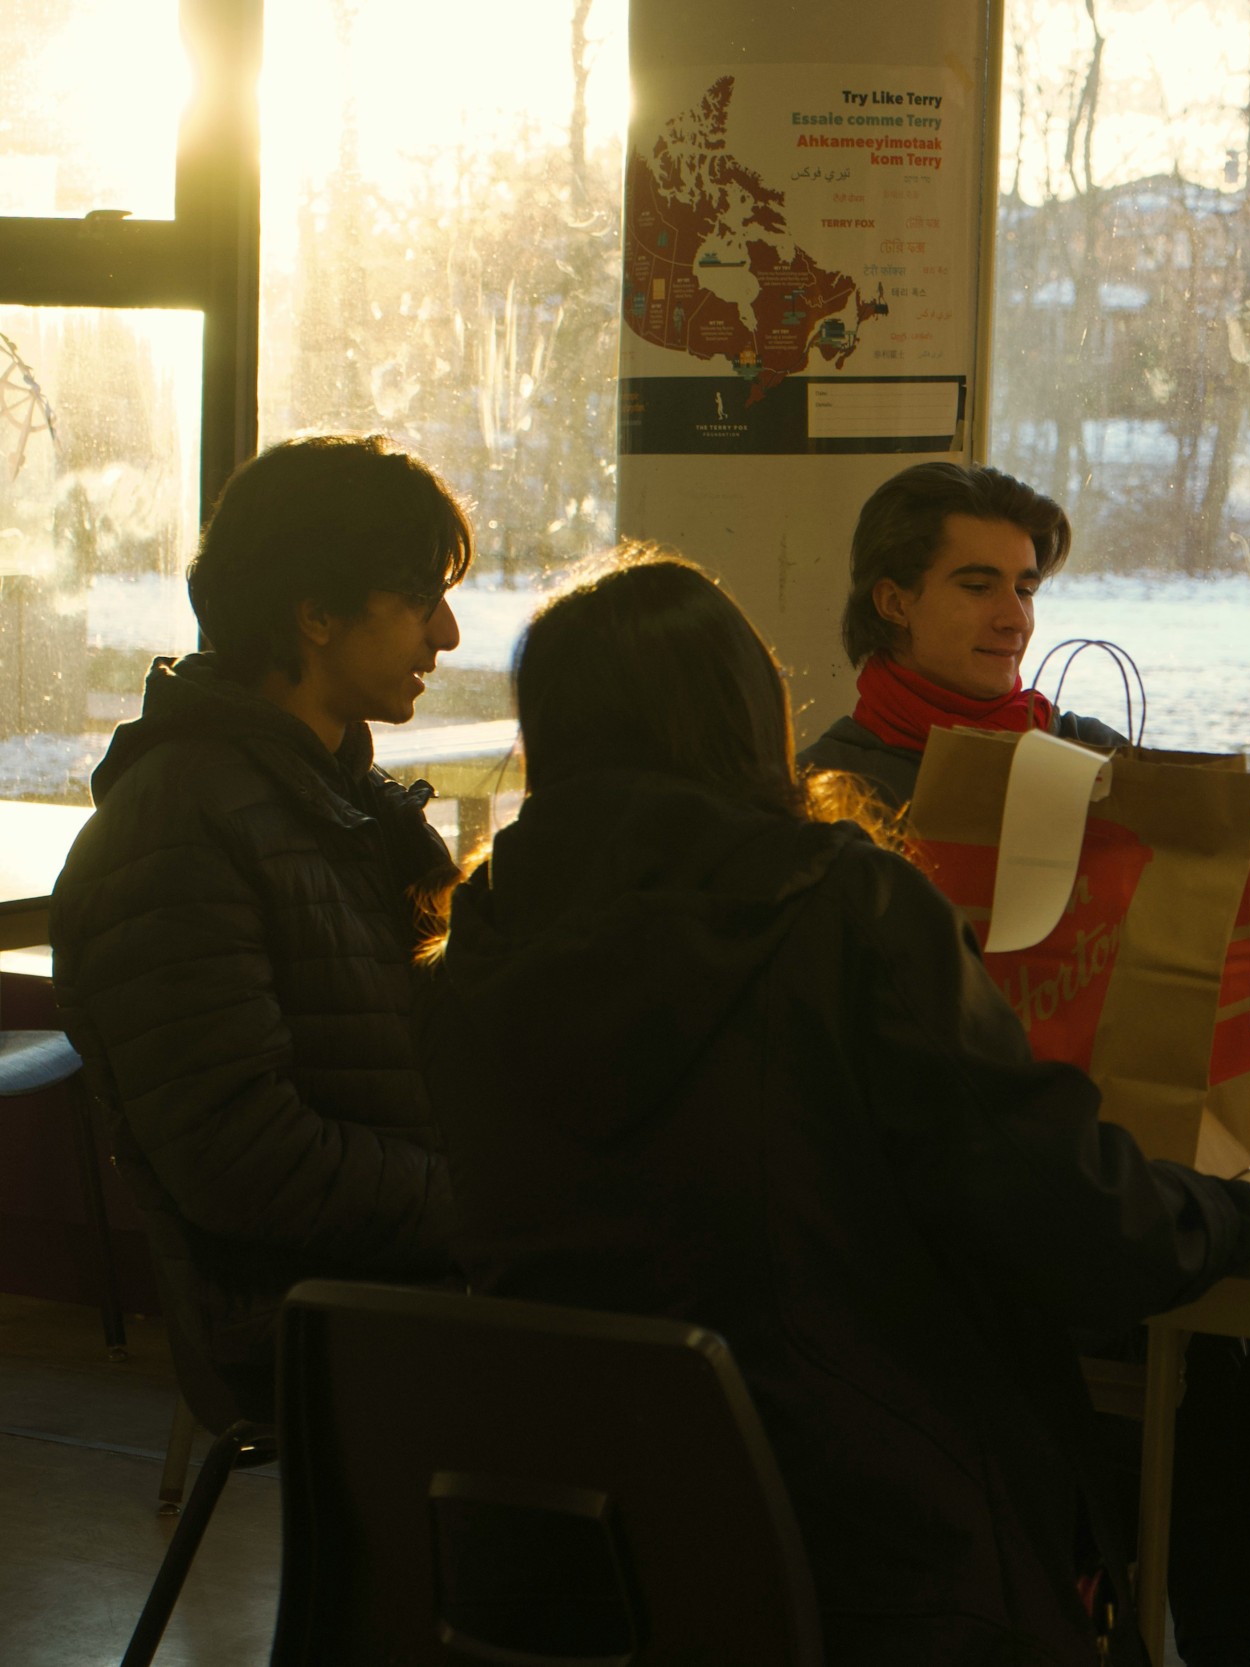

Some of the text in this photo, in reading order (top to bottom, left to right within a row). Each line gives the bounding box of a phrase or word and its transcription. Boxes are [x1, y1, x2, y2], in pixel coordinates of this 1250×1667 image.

[842, 90, 942, 109] Try Like Terry
[791, 112, 942, 130] Essaie comme Terry
[796, 134, 942, 151] Ahkameeyimotaak
[870, 152, 942, 169] kom Terry
[821, 219, 875, 228] TERRY FOX
